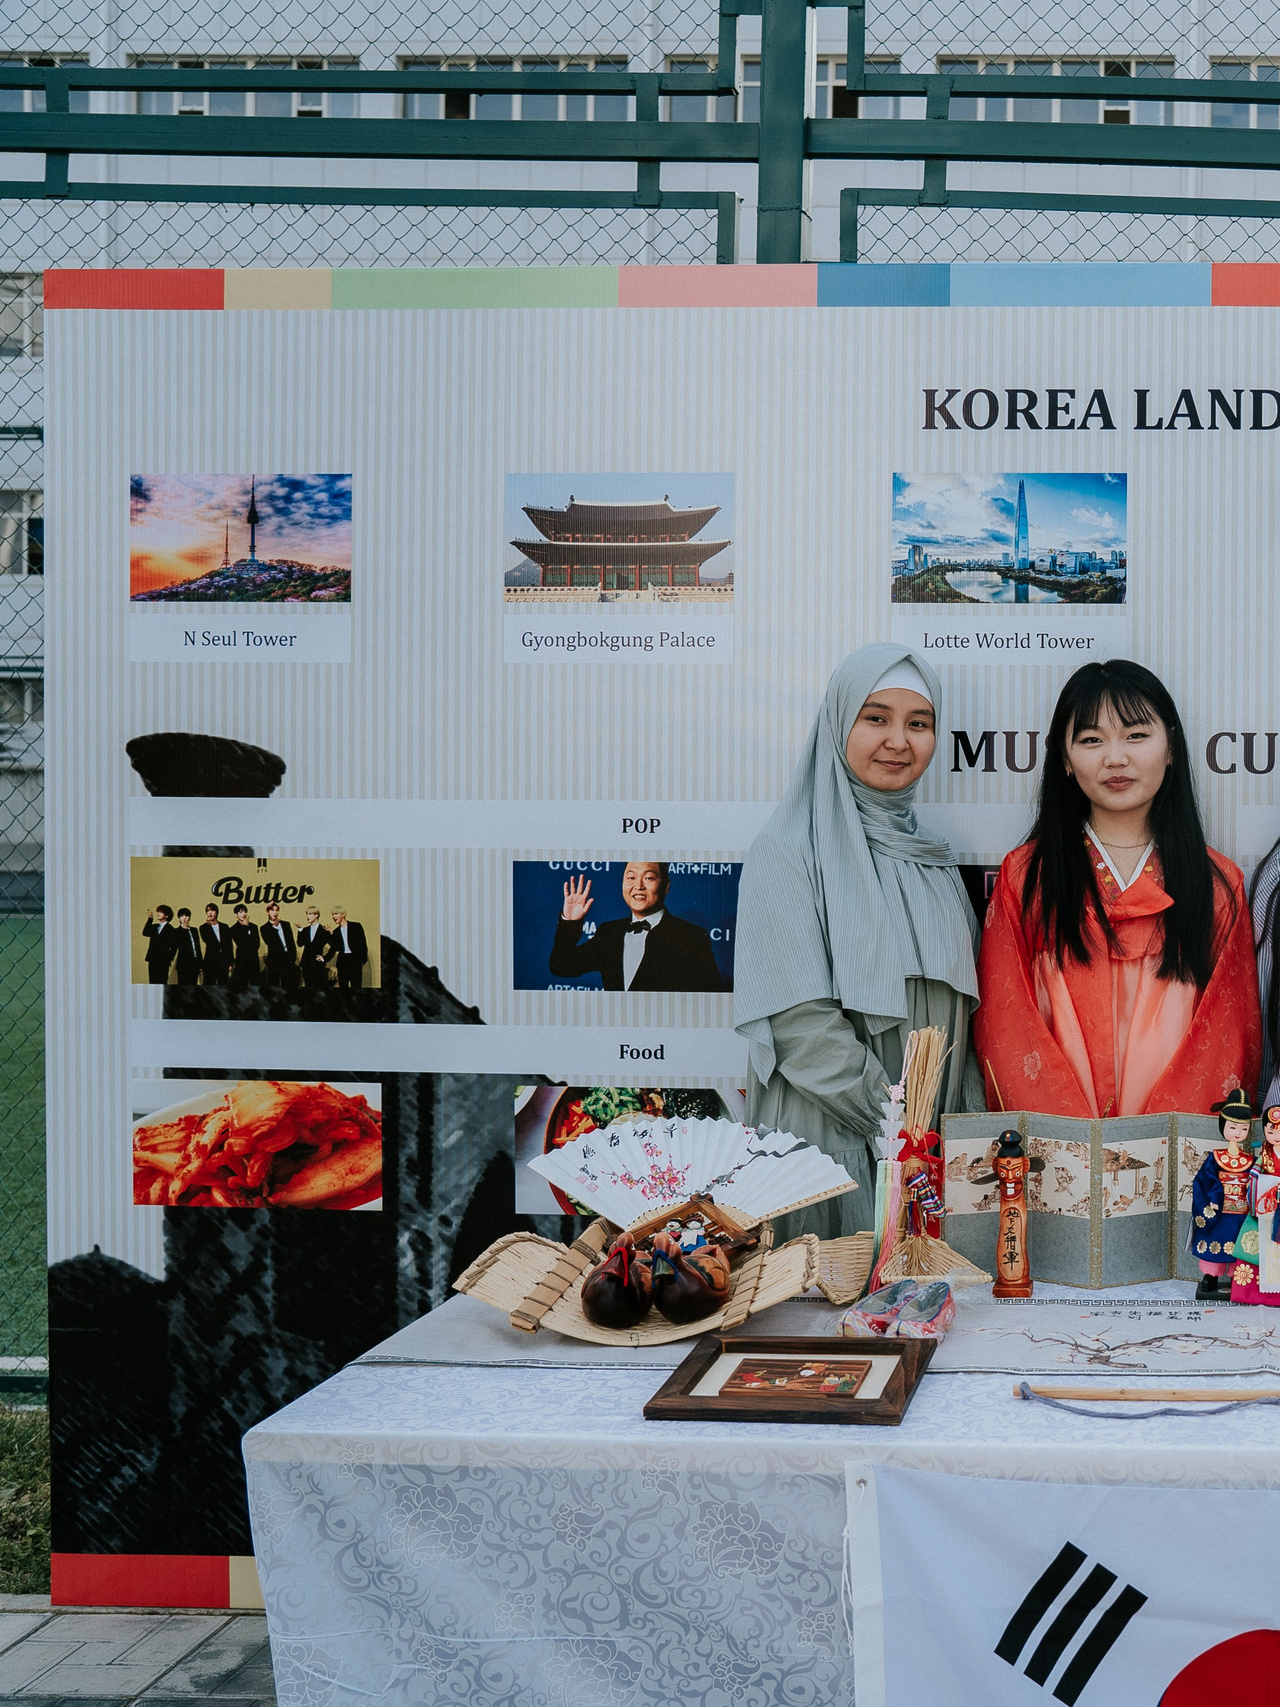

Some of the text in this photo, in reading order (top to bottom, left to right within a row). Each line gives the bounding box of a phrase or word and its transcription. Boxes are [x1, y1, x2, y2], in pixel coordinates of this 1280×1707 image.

[921, 388, 1117, 433] KOREA
[184, 630, 297, 647] N Seul Tower
[521, 631, 716, 652] Gyongbokgung Palace
[923, 632, 1095, 650] Lotte World Tower
[621, 818, 661, 834] POP
[549, 861, 610, 871] GUCCI
[211, 876, 315, 905] Butter
[619, 1044, 665, 1060] Food
